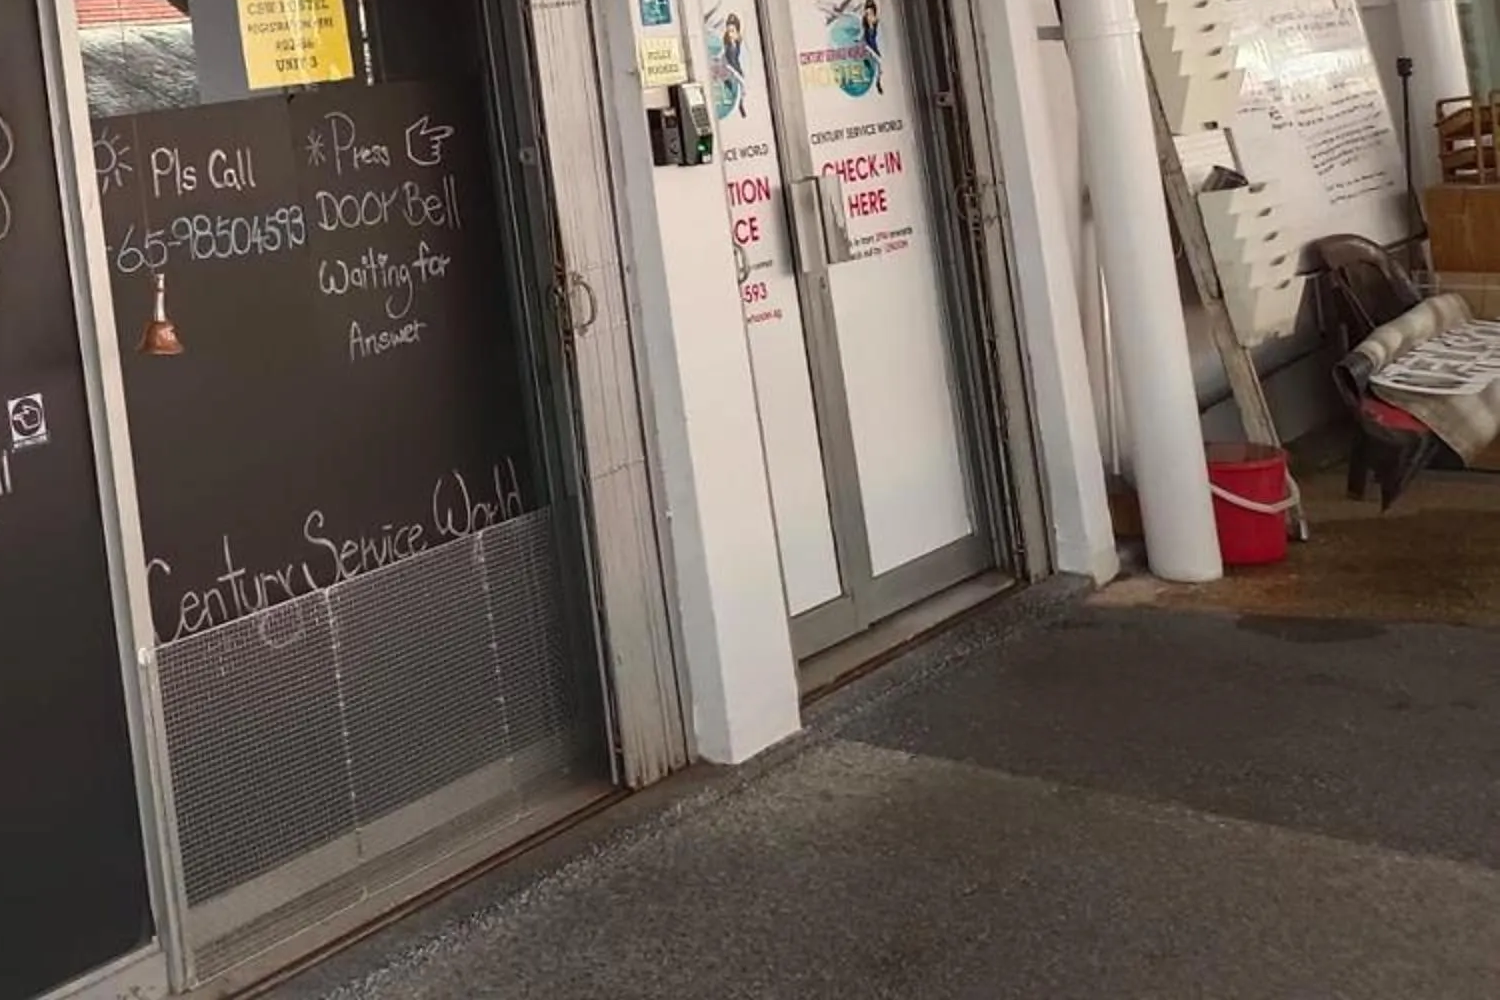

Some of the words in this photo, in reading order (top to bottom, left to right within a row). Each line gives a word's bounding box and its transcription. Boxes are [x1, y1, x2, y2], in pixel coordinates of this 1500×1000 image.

[324, 111, 392, 176] Press
[150, 147, 198, 198] Pls
[208, 148, 257, 191] Call
[402, 174, 463, 231] Bell
[847, 188, 888, 218] HERE
[416, 238, 452, 278] for
[347, 319, 428, 362] Answer
[303, 509, 428, 590] Service
